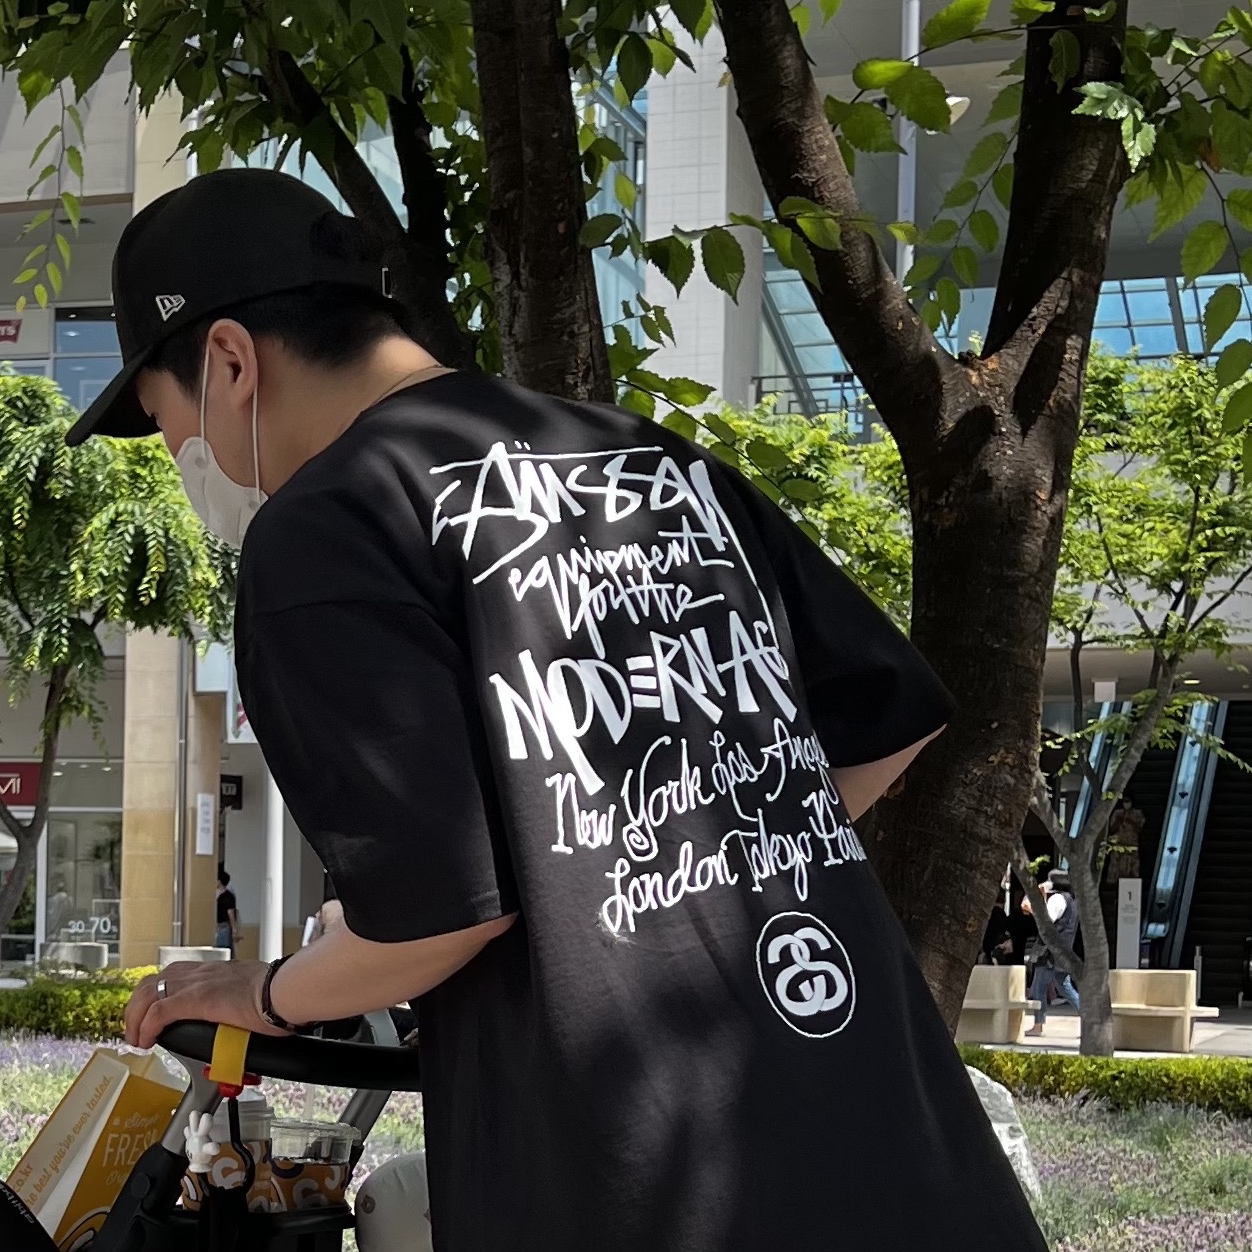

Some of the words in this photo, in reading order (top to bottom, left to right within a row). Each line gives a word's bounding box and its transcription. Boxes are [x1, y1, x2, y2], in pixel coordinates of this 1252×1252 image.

[489, 627, 727, 796] MODERN
[545, 771, 617, 855] New
[621, 735, 715, 861] York
[601, 841, 739, 933] London
